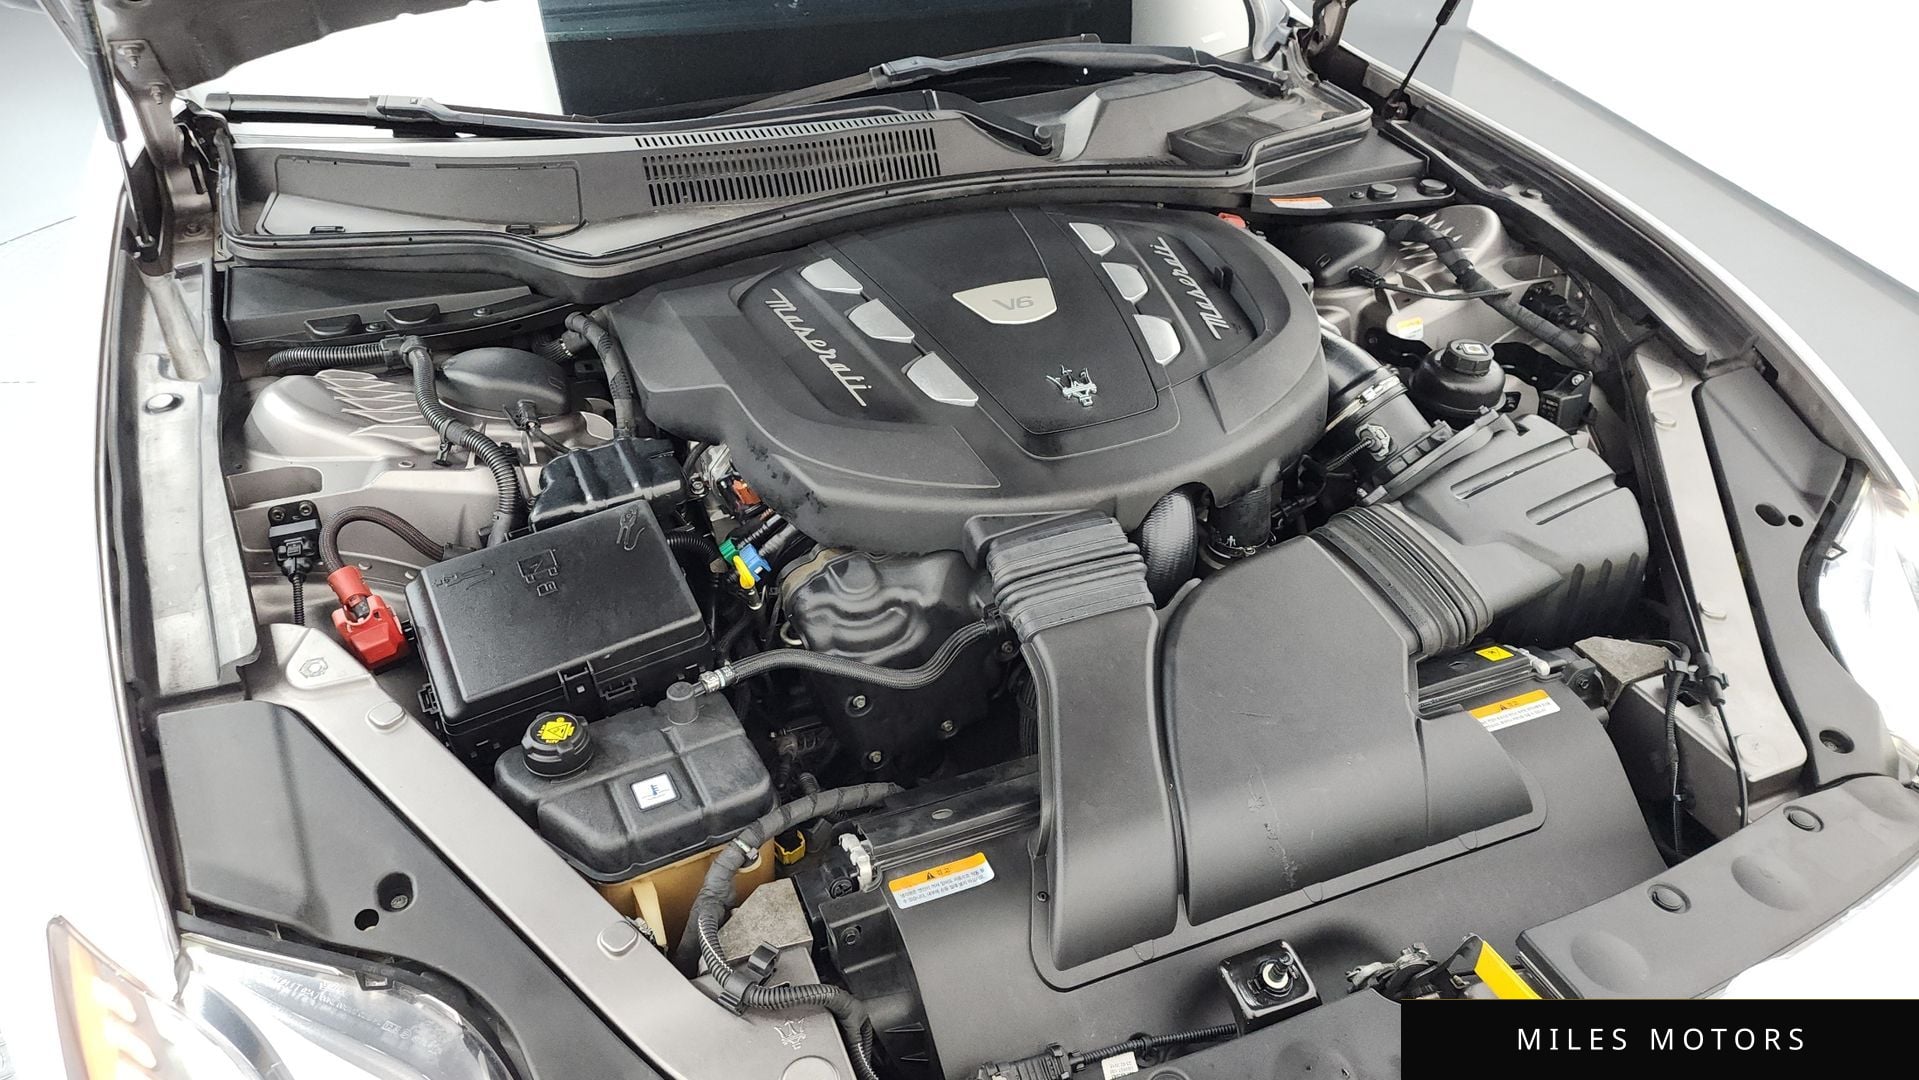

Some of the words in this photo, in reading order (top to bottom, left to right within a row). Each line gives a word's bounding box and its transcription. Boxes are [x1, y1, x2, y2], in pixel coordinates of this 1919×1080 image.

[991, 296, 1034, 310] V6
[1150, 236, 1230, 340] Maserati
[765, 288, 872, 407] Maserati
